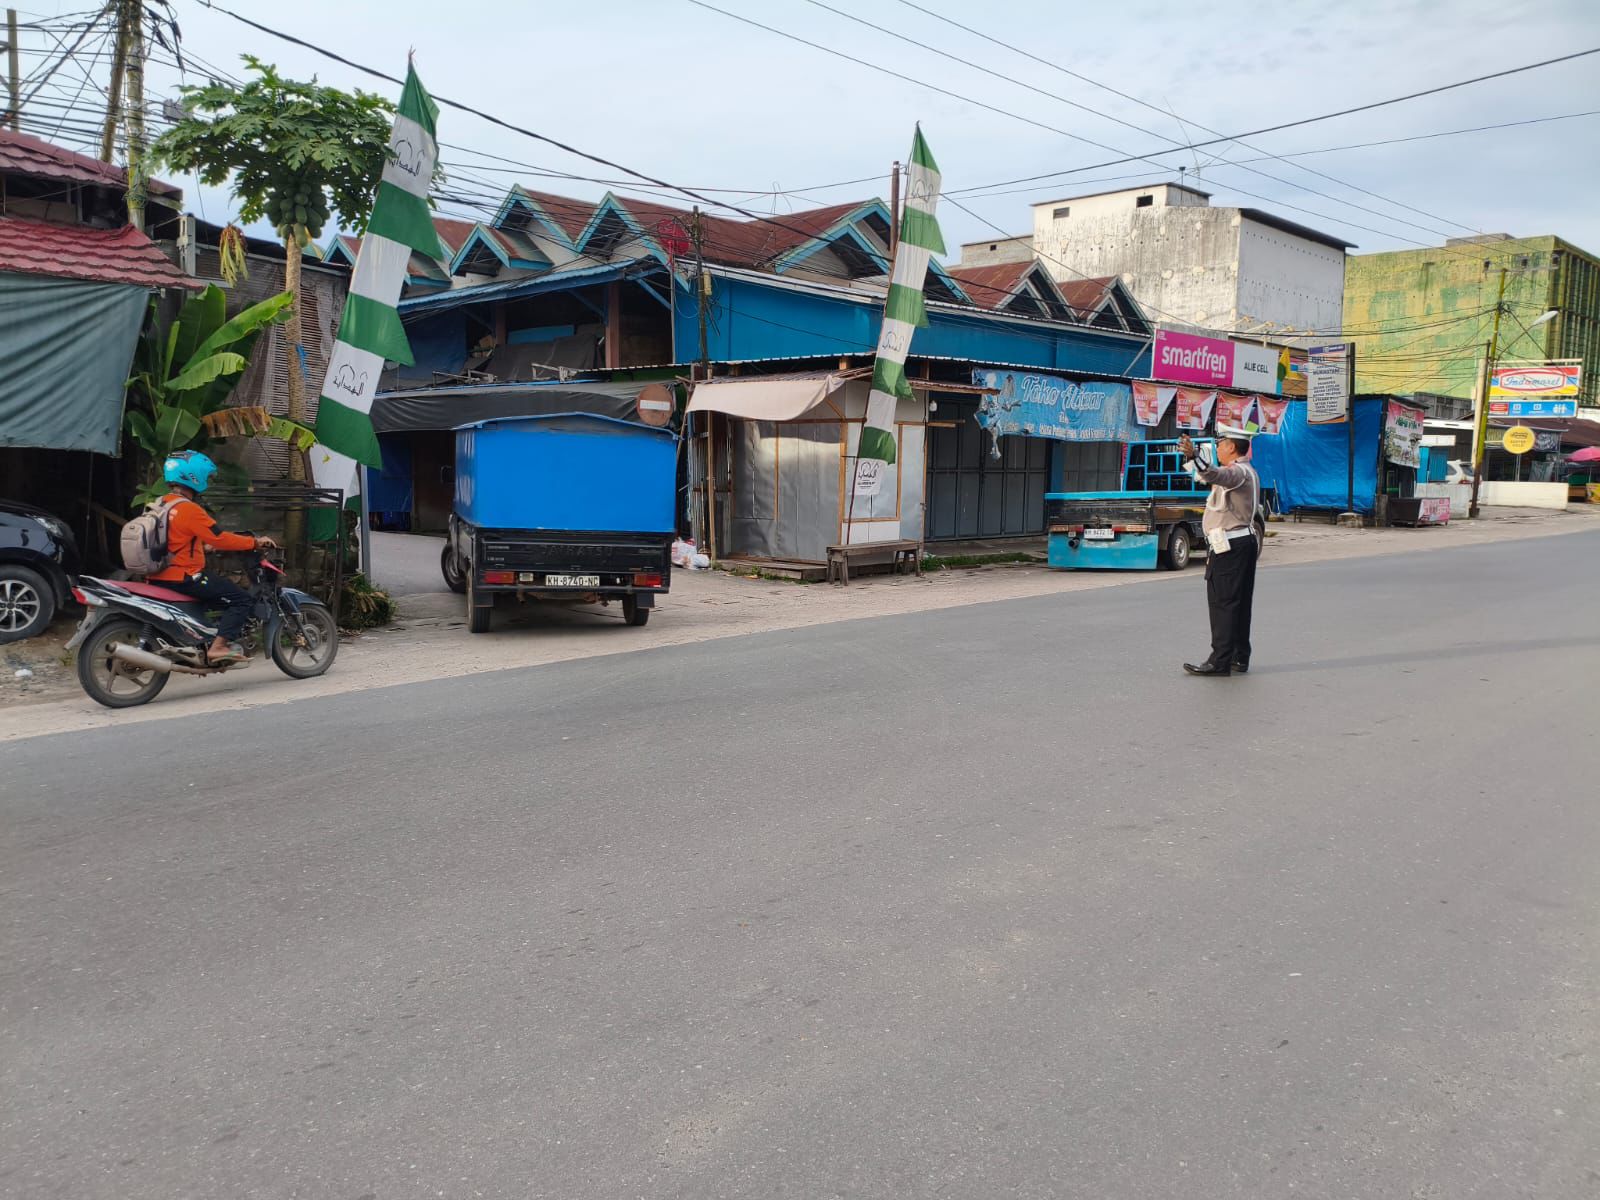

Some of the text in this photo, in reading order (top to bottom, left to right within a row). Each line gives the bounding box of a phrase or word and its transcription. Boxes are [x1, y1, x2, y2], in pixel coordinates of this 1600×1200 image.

[1161, 345, 1226, 373] smartfren
[1243, 362, 1269, 374] ALIE CELL
[1021, 375, 1060, 406] Toko
[1504, 376, 1560, 387] Indomaret
